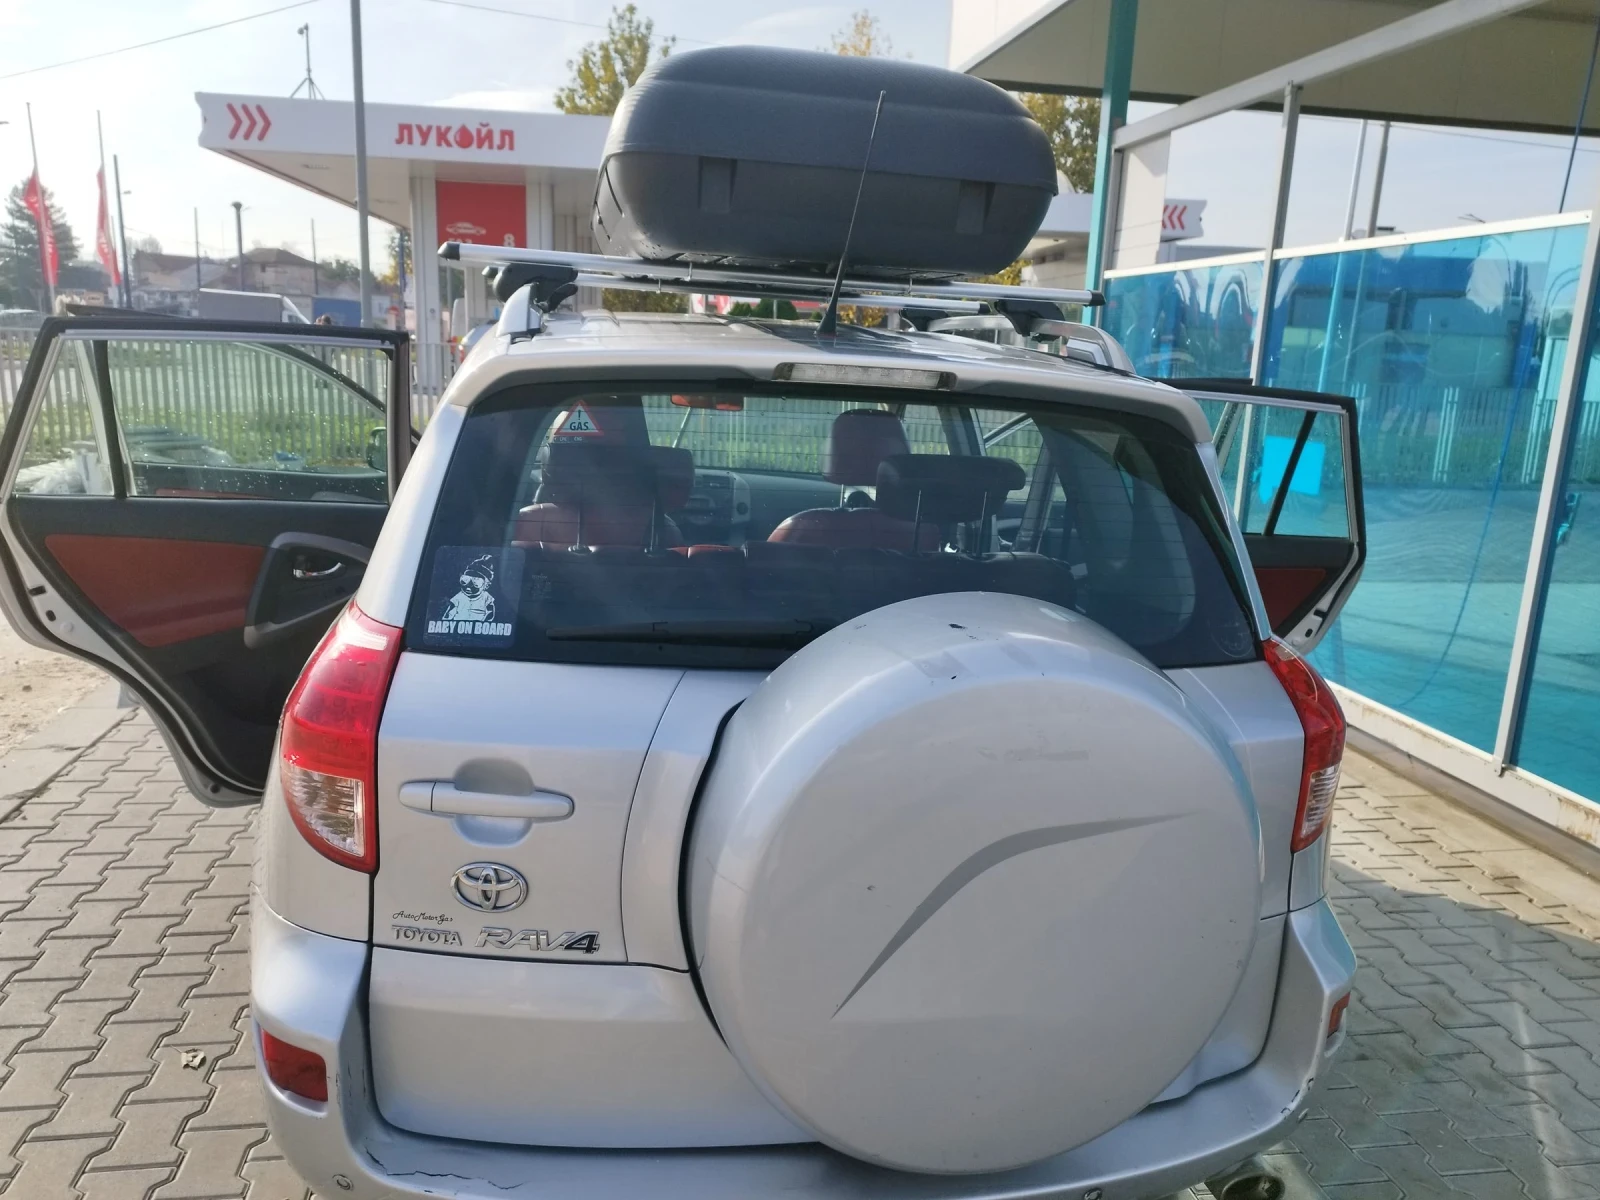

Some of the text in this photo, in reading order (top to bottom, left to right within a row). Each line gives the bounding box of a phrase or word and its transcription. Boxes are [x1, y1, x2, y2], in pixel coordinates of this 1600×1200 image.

[569, 421, 589, 431] GAS
[428, 620, 512, 636] BABY ON BOARD
[391, 925, 600, 954] TOYOTA RAV4
